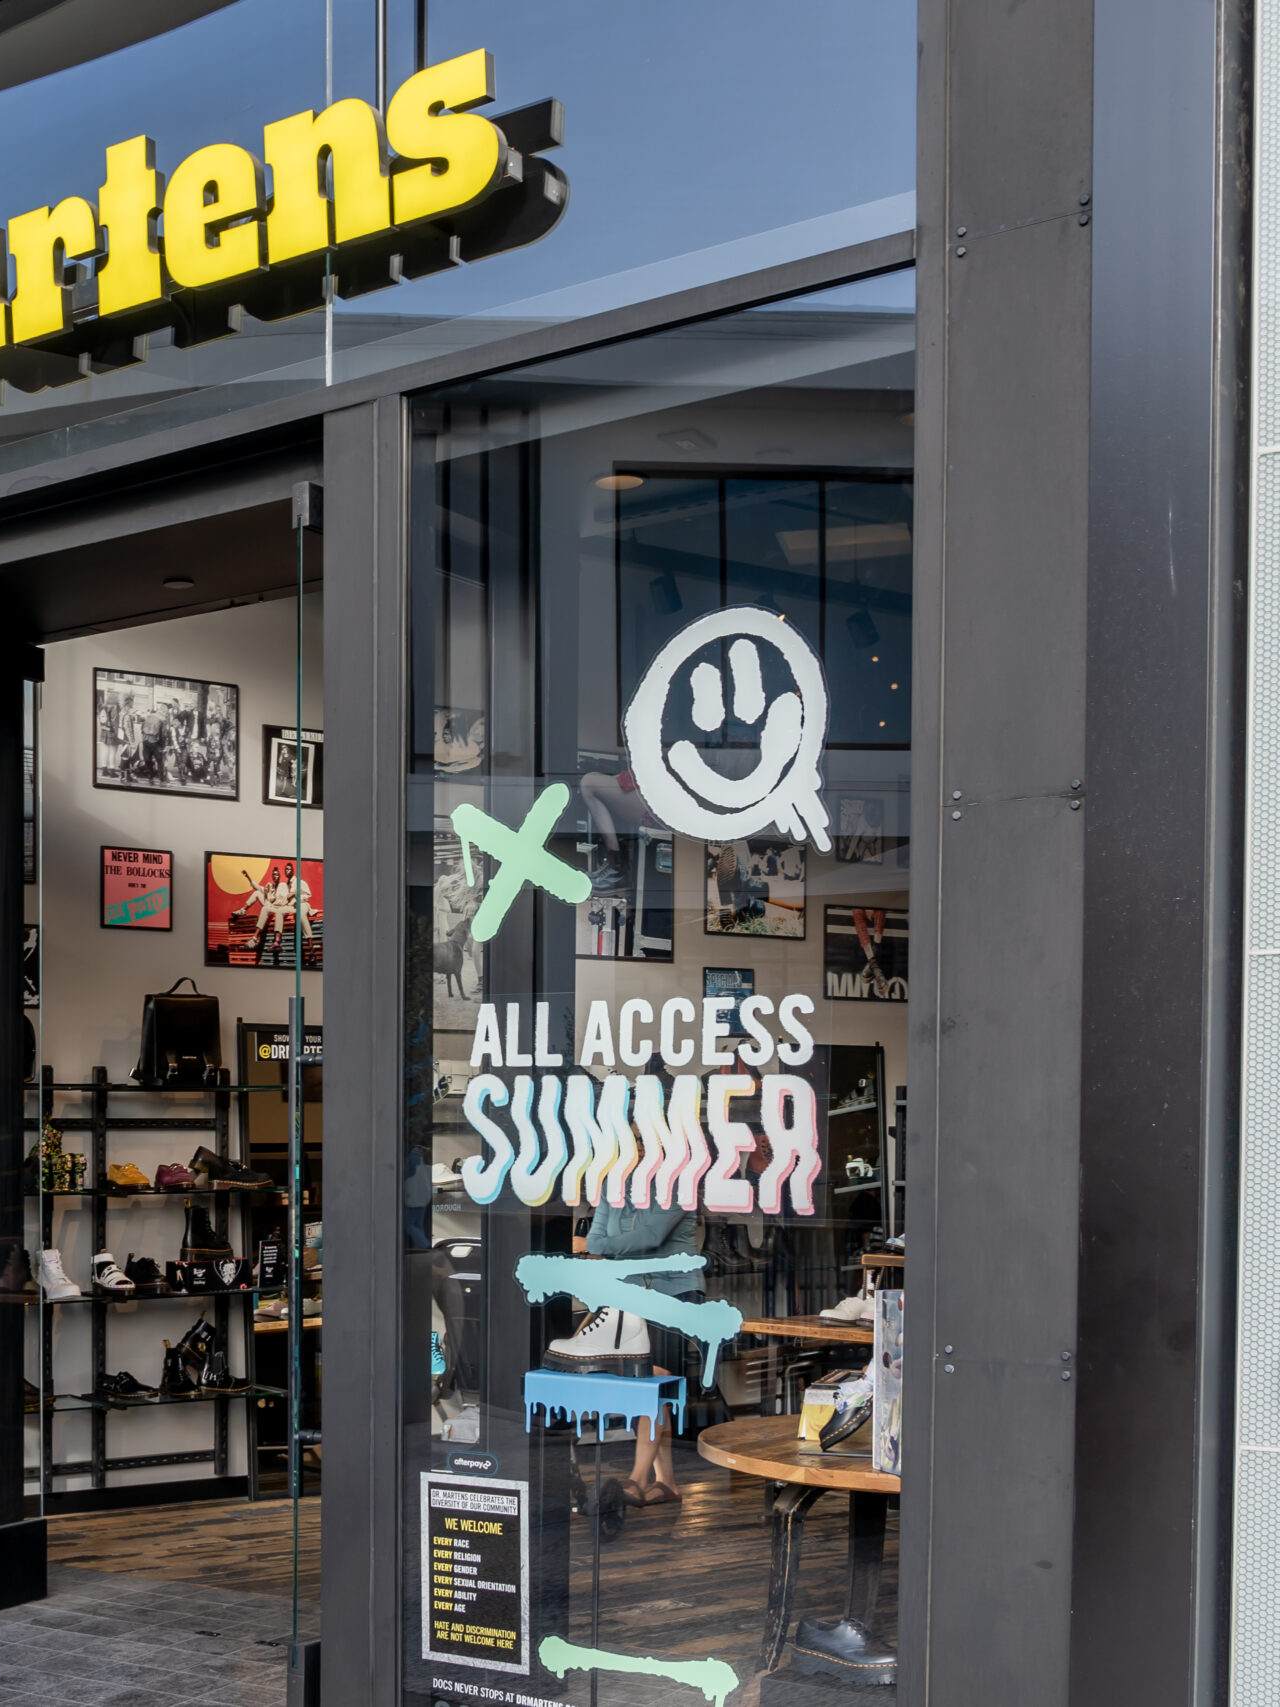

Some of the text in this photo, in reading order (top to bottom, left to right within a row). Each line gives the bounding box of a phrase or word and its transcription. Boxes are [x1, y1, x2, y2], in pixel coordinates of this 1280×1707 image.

[111, 851, 163, 865] NEVER MIND
[104, 865, 170, 878] THE BOLLOCKS
[470, 994, 815, 1067] ALL ACCESS
[305, 1035, 322, 1043] YOUR
[462, 1074, 822, 1214] SUMMER
[453, 1458, 484, 1469] afterpay
[432, 1490, 516, 1506] DR. MARTENS CELEBRATES THE
[432, 1498, 517, 1514] DIVERSITY OF OUR COMMUNITY
[445, 1517, 503, 1535] WE WELCOME
[433, 1536, 470, 1548] EVERY RACE
[433, 1549, 481, 1563] EVERY RELIGION
[433, 1562, 478, 1575] EVERY GENDER
[433, 1575, 516, 1593] EVERY SEXUAL ORIENTATION
[433, 1588, 477, 1601] EVERY ABILITY
[433, 1601, 466, 1613] EVERY AGE
[434, 1620, 516, 1640] HATE AND DISCRIMINATION
[436, 1630, 514, 1650] ARE NOT WELCOME HERE
[432, 1678, 453, 1691] DOCS
[454, 1681, 478, 1696] NEVER
[480, 1687, 504, 1701] STOPS
[505, 1692, 514, 1703] AT
